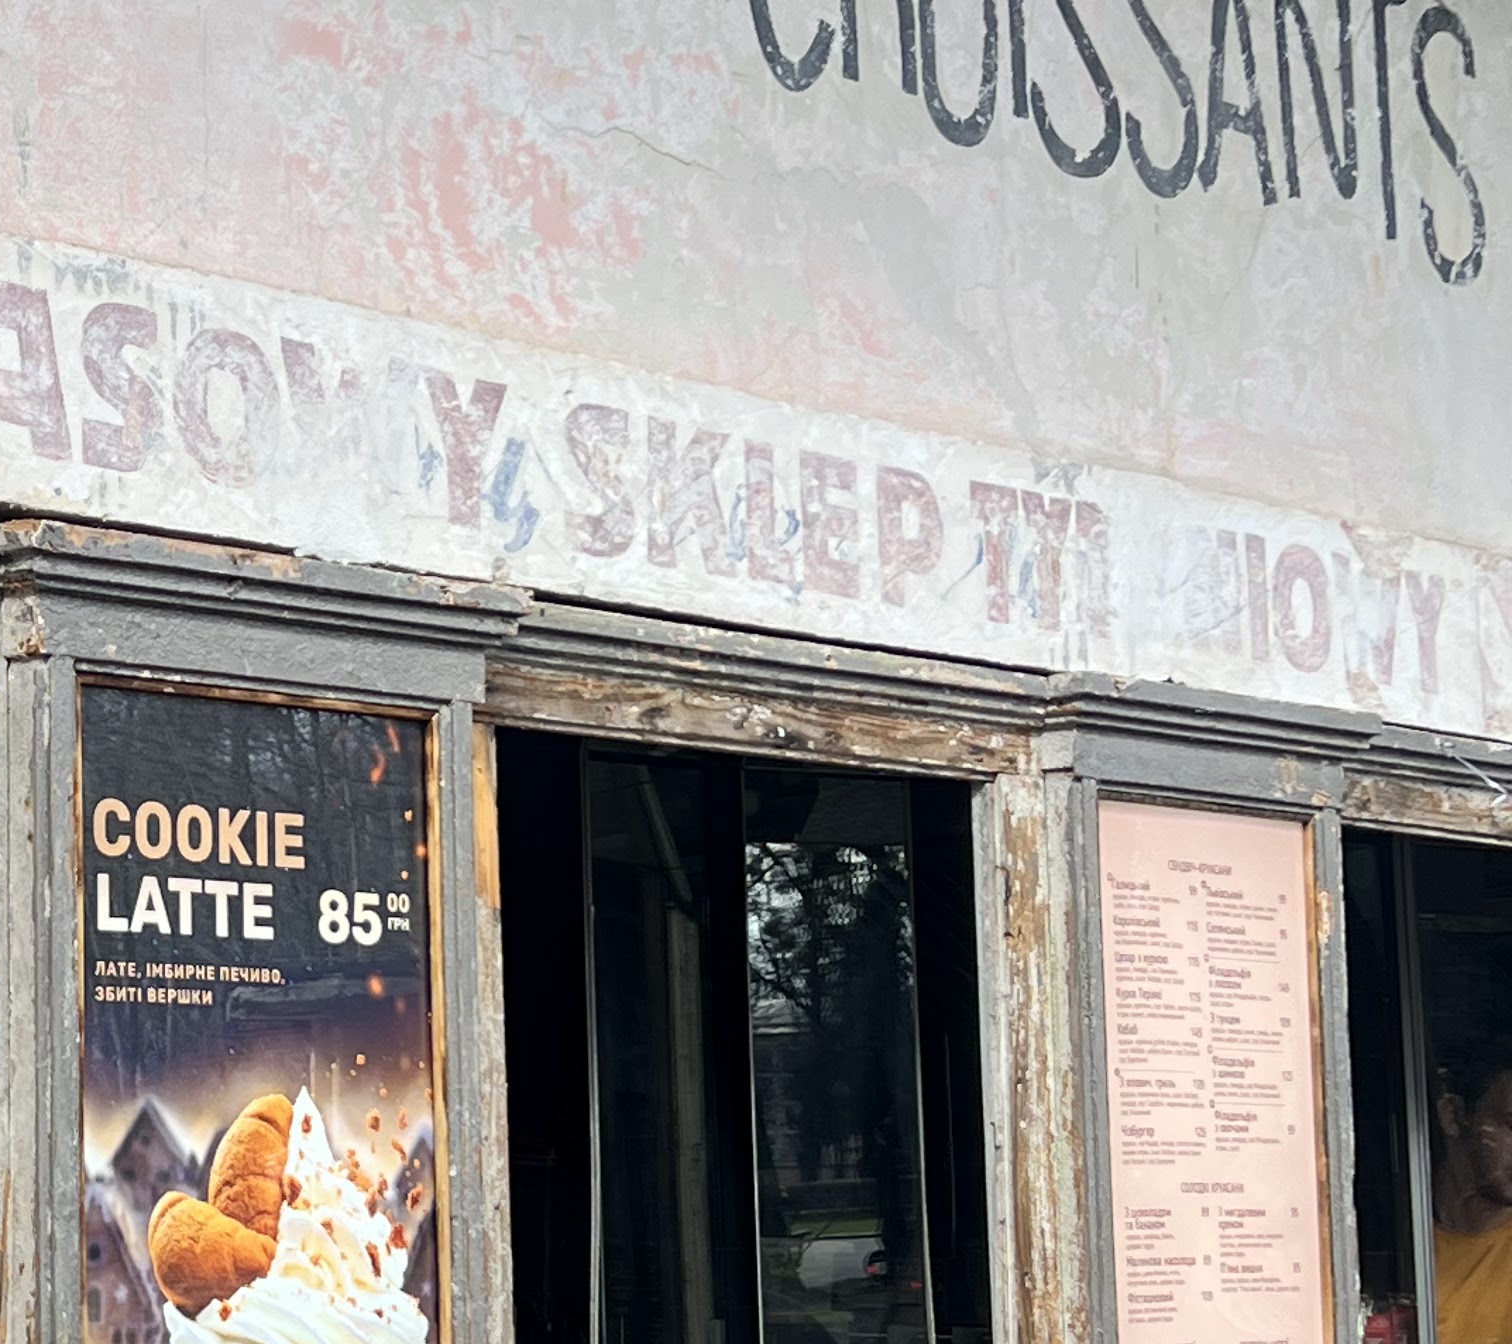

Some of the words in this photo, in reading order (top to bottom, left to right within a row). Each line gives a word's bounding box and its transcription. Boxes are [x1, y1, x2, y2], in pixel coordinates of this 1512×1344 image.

[564, 403, 945, 606] SKLEP
[93, 797, 306, 870] COOKIE
[96, 872, 275, 941] LATTE
[94, 960, 142, 979] ЛАТЕ,
[146, 963, 216, 982] ІМБИРНЕ
[94, 987, 142, 1004] ЗБИТІ
[146, 988, 214, 1006] ВЕРШКИ
